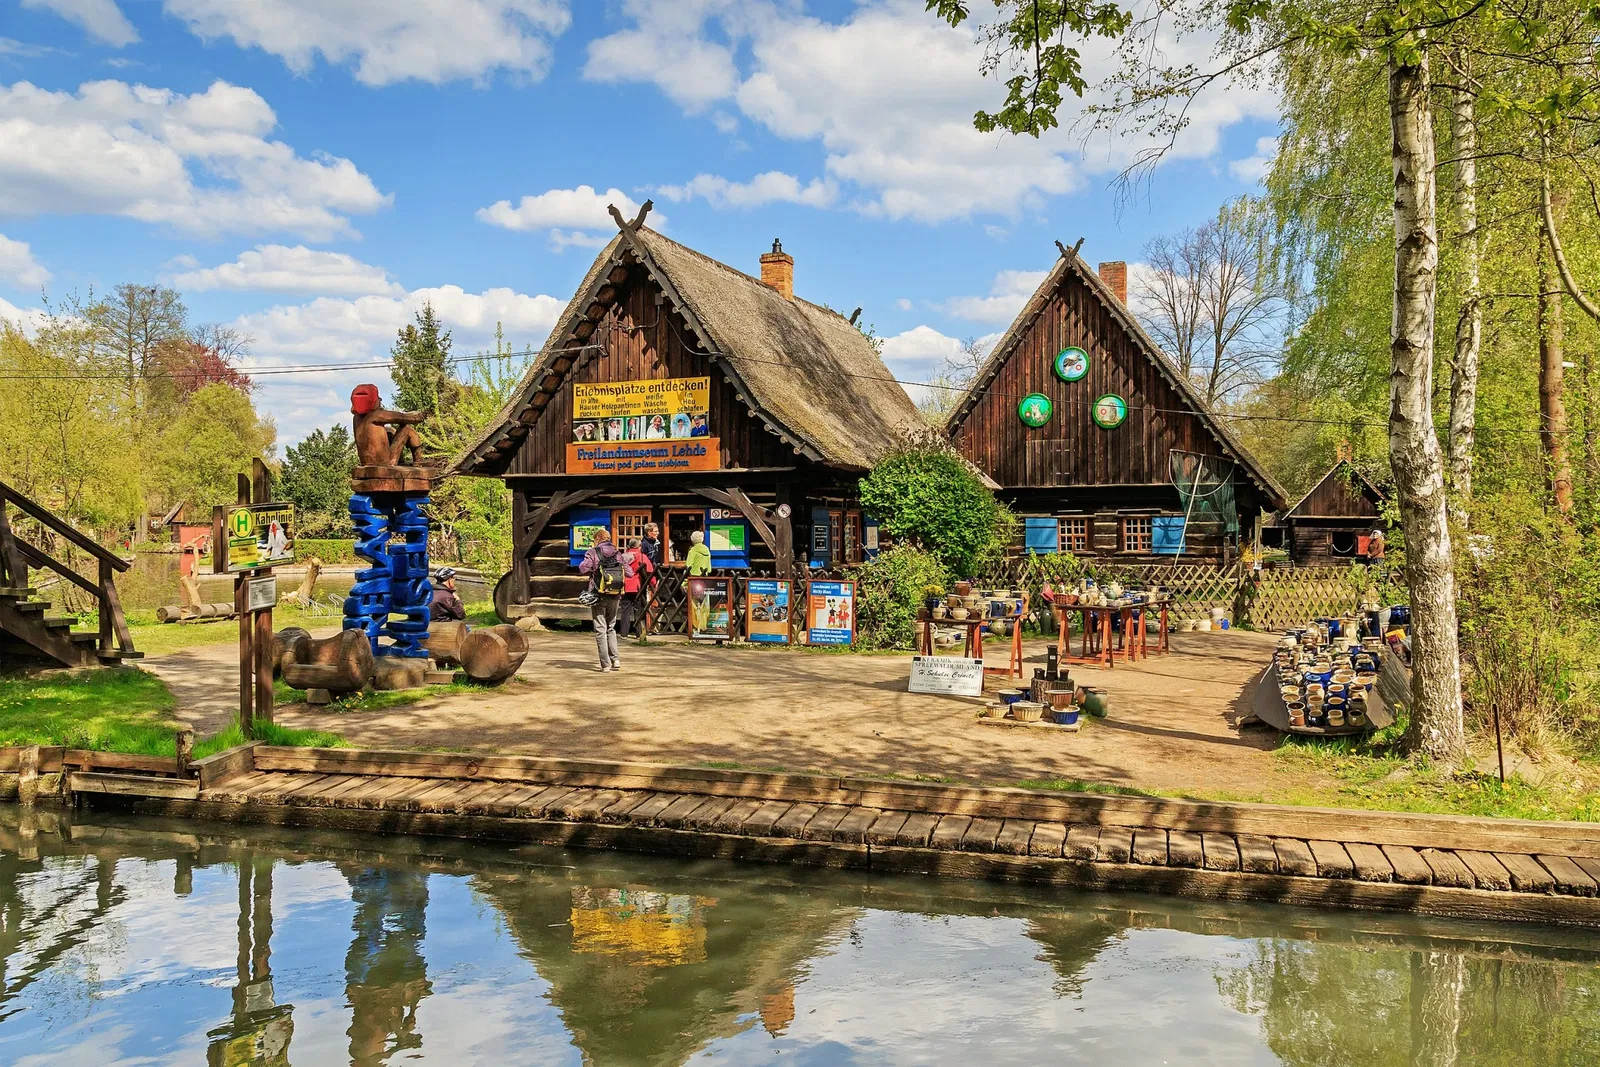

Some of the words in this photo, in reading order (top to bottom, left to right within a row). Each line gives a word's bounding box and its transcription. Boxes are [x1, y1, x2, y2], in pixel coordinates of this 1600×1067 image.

[576, 384, 646, 397] Erlebnisplätze
[648, 378, 708, 392] entdecken!
[577, 446, 668, 460] Freilandmuseum
[672, 443, 706, 457] Lehde
[617, 460, 632, 470] pod
[256, 510, 292, 524] Kahnlinie
